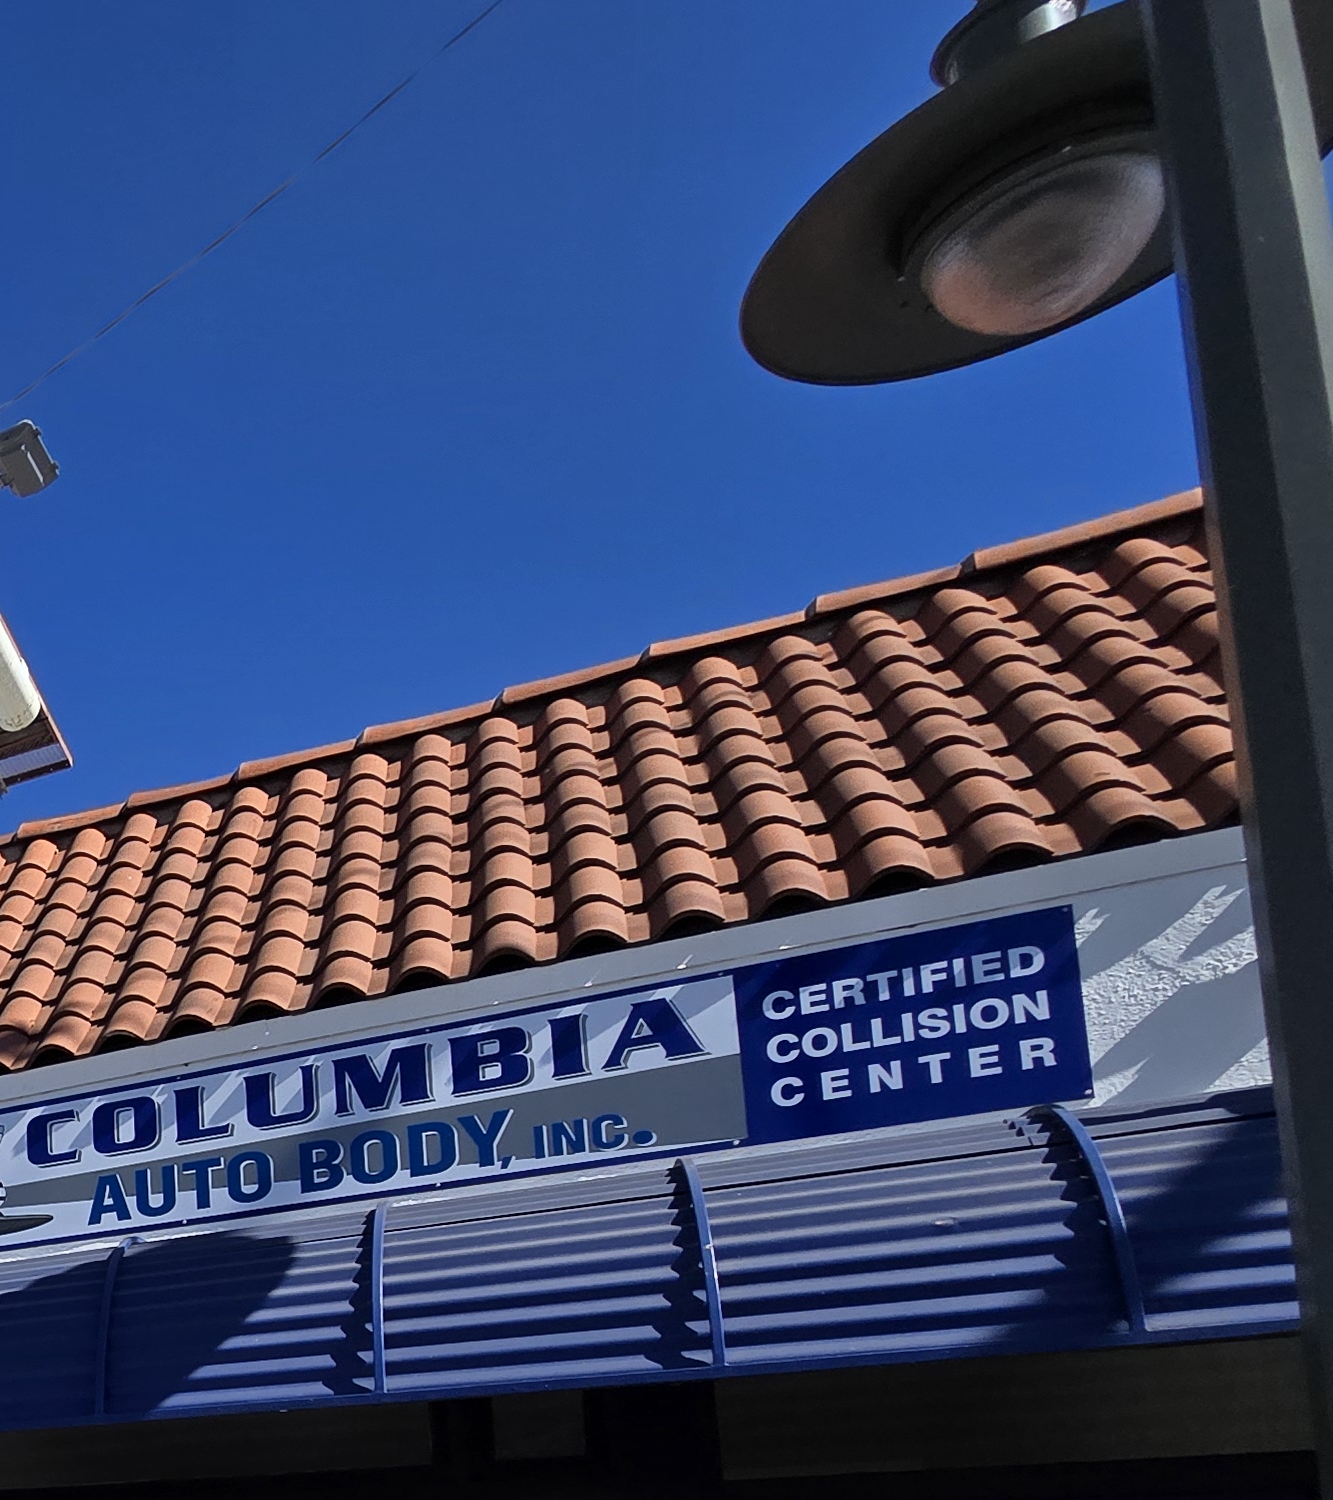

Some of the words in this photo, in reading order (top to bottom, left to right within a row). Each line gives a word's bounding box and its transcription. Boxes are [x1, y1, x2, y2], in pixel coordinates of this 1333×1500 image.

[762, 946, 1045, 1020] CERTIFIED
[766, 990, 1051, 1063] COLLISION
[25, 997, 712, 1168] COLUMBIA
[770, 1037, 1057, 1107] CENTER
[87, 1150, 275, 1226] AUTO
[299, 1108, 514, 1196] BODY,
[533, 1113, 658, 1160] INC.
